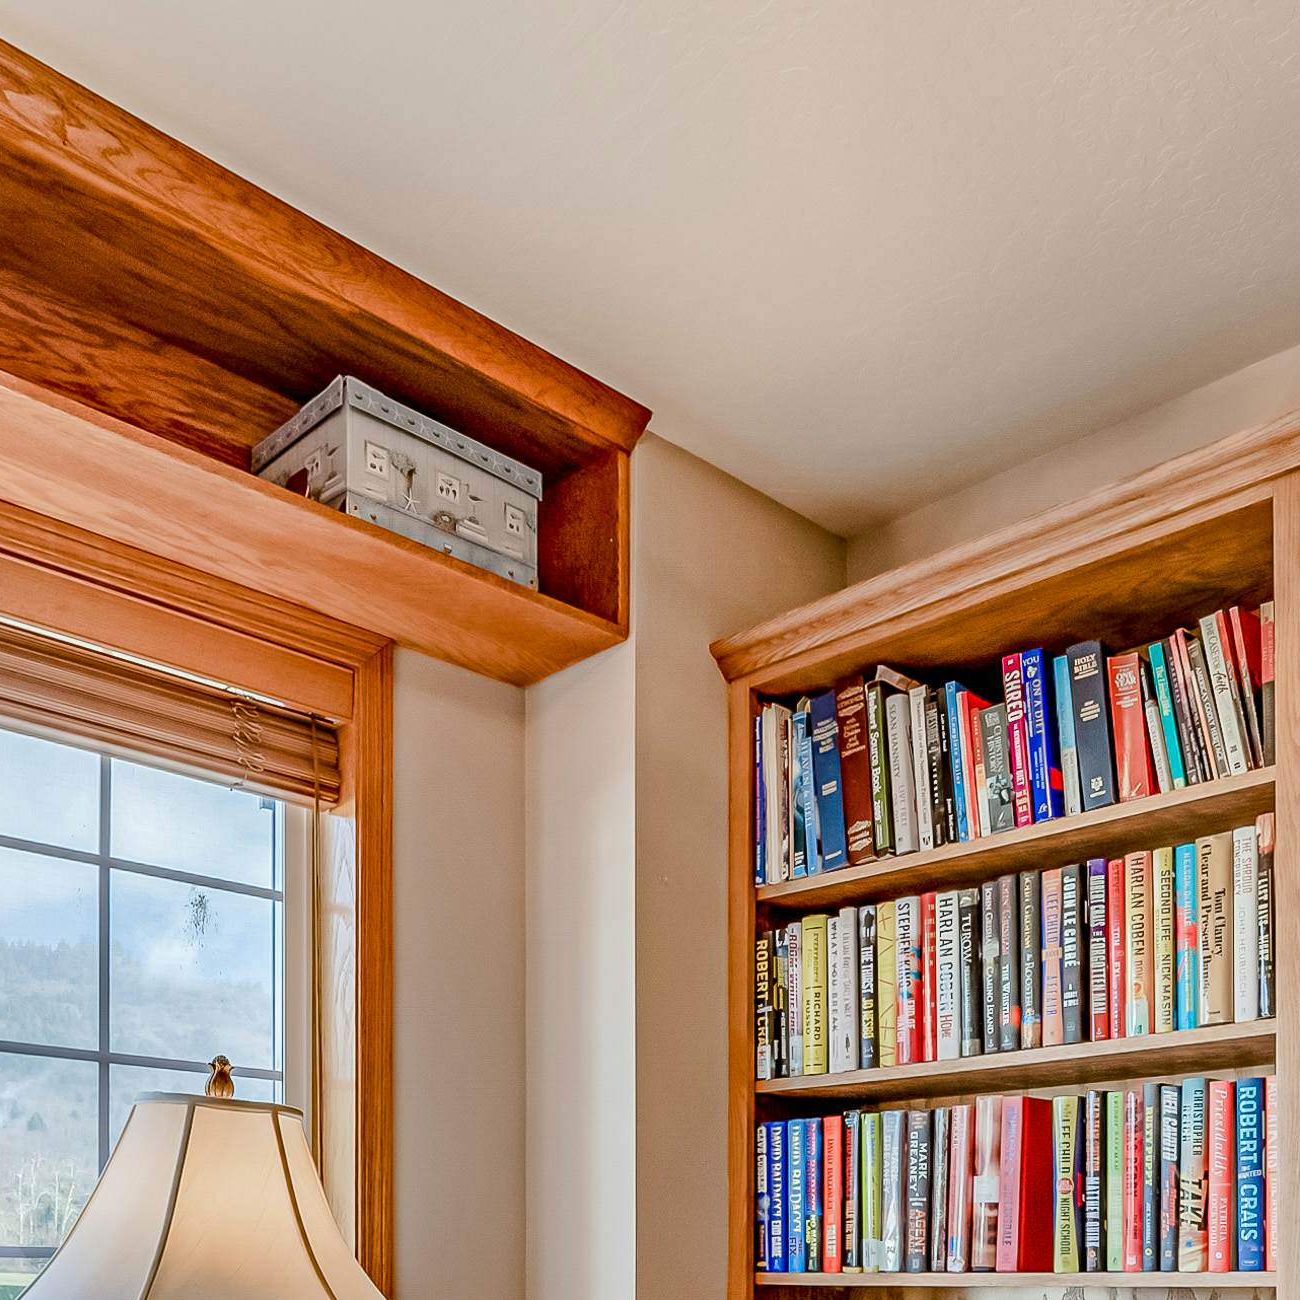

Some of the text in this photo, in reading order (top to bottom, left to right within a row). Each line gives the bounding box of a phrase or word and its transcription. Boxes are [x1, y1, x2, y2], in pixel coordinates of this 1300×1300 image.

[1022, 656, 1039, 666] YOU
[1074, 653, 1096, 666] HOLY
[1074, 660, 1097, 674] BIBLE
[1210, 636, 1220, 656] CASE
[1004, 671, 1022, 722] SHRED
[1200, 843, 1212, 874] Clear
[1242, 837, 1252, 854] THE
[1063, 876, 1076, 926] JOHN LE
[1130, 857, 1145, 956] HARLAN COBEN
[1214, 888, 1226, 958] Tom Clancy
[897, 903, 910, 954] STEPHEN
[939, 897, 953, 957] HARLAN
[960, 913, 972, 963] TUROW
[1046, 913, 1059, 943] CHILD
[1161, 918, 1171, 940] LIFE
[756, 940, 769, 1005] ROBERT
[861, 945, 874, 994] THE THIRST
[1091, 937, 1106, 991] FORGOTTEN
[1161, 954, 1171, 981] NICK
[1161, 985, 1171, 1025] MASON
[1163, 1090, 1178, 1117] NEIL
[1192, 1089, 1204, 1156] CHRISTOPHER
[1163, 1118, 1178, 1161] CAVUTO
[1213, 1089, 1227, 1177] Priestdaddy
[771, 1126, 783, 1218] DAVID BALDACCI
[909, 1132, 919, 1191] GREANEY
[1239, 1086, 1258, 1241] ROBERT CRAIS
[790, 1168, 802, 1232] BALDACCI
[915, 1209, 926, 1255] AGENT
